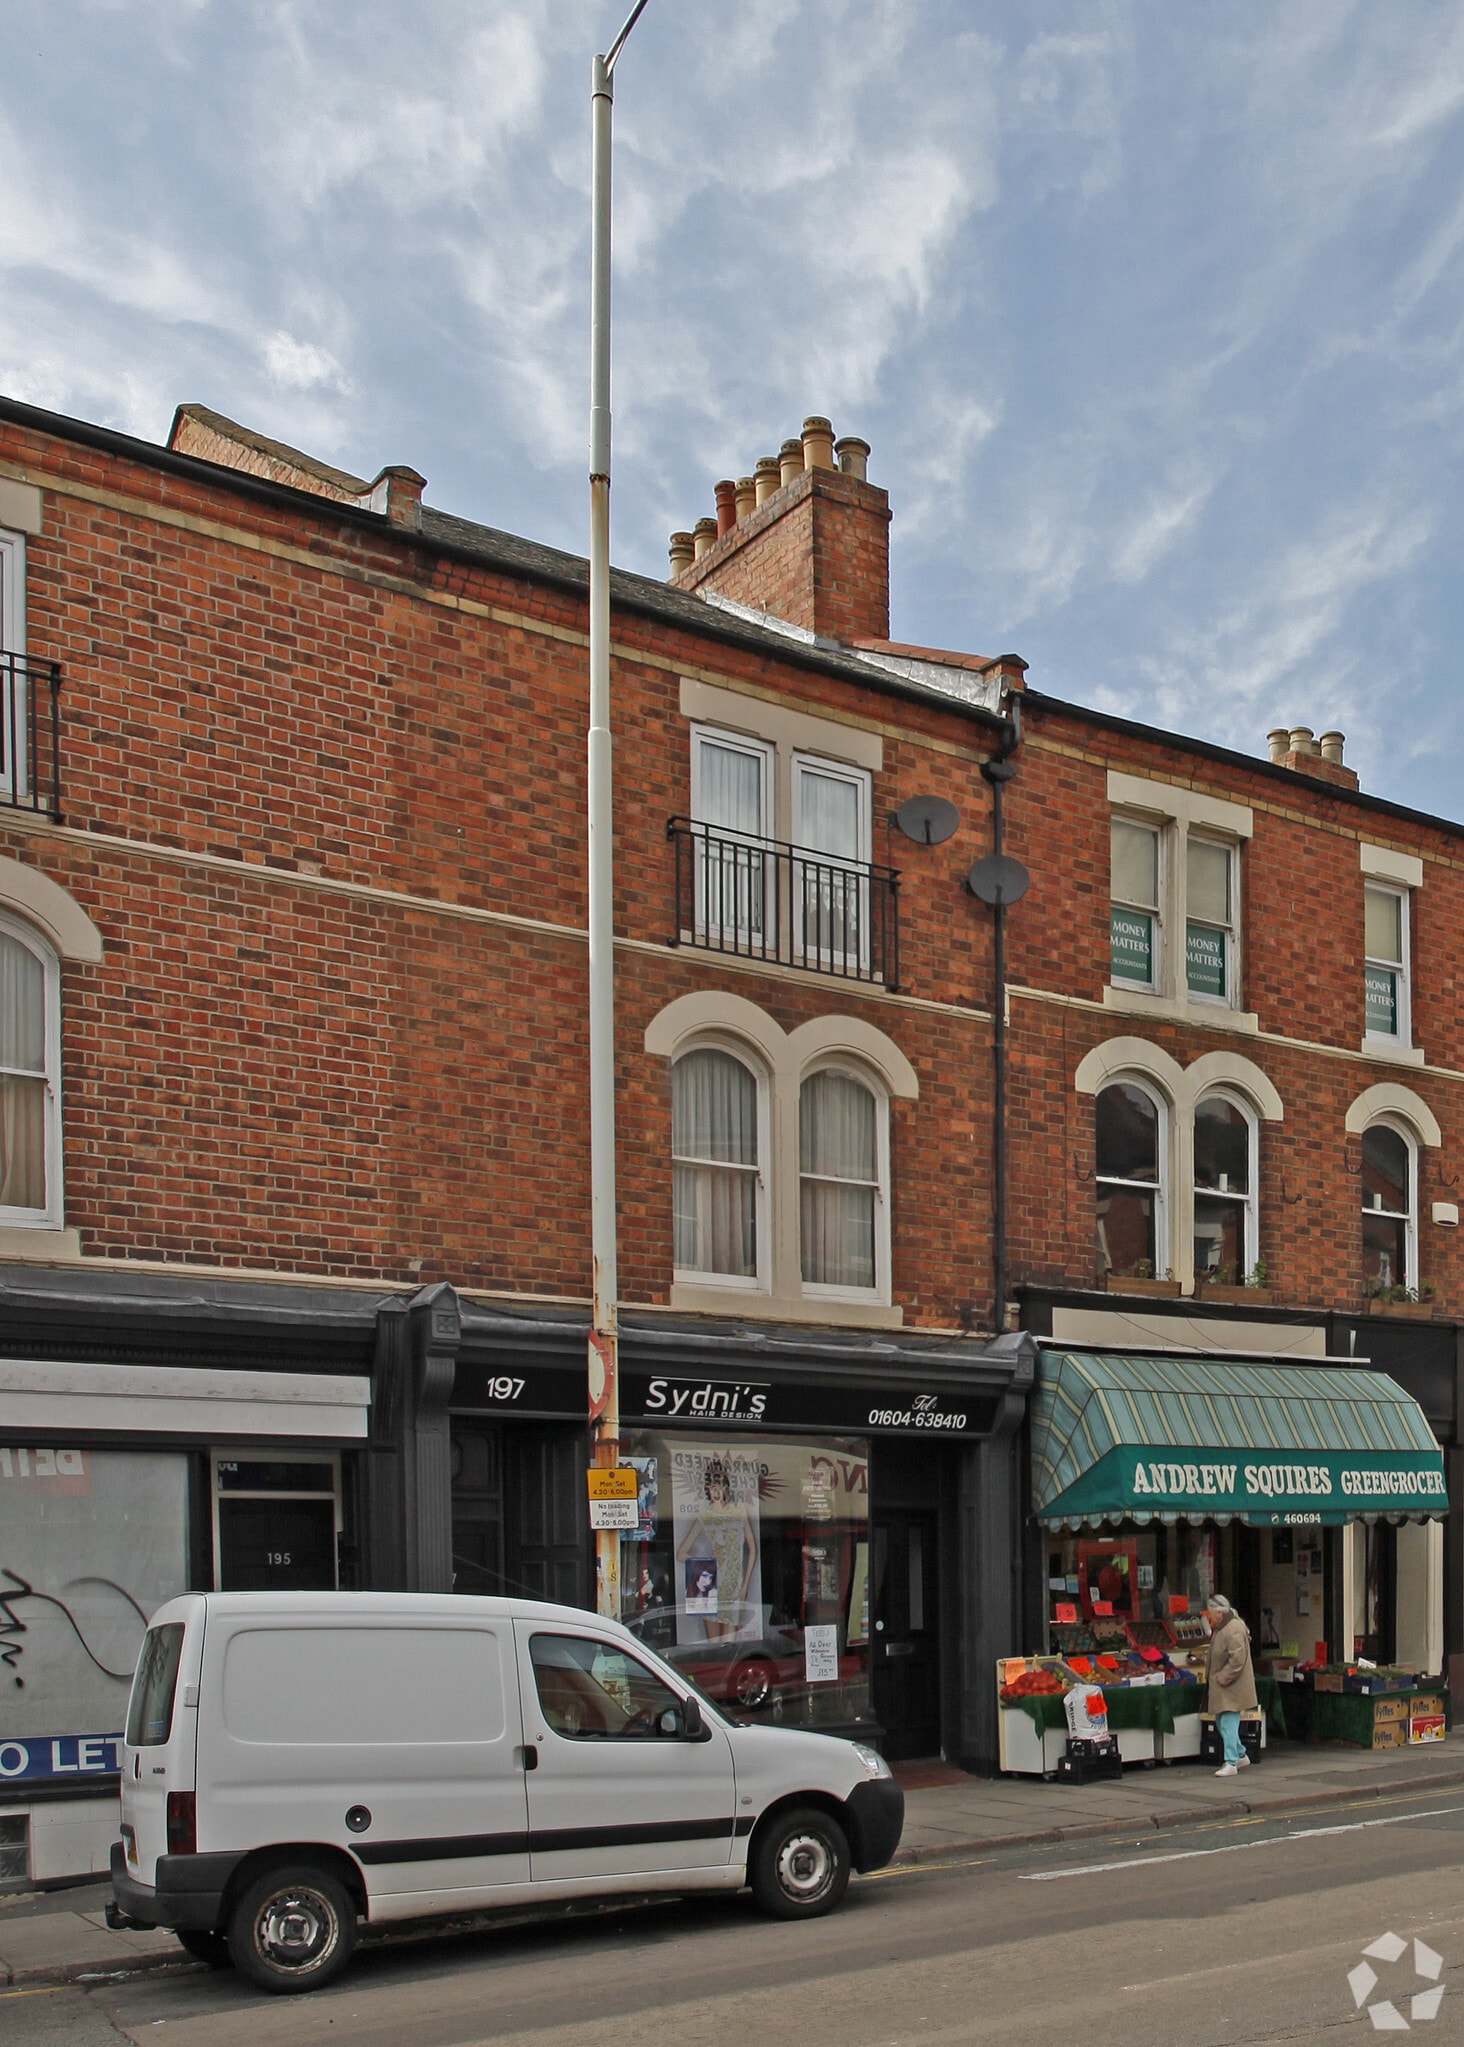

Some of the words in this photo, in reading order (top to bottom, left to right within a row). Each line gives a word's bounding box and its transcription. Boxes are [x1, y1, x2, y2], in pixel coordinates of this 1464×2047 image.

[1112, 921, 1146, 938] MONEY
[1110, 935, 1150, 953] MATTERS
[1187, 937, 1220, 953] MONEY
[1113, 957, 1147, 970] ACCOUNTANTS
[1186, 951, 1223, 968] MATTERS
[1188, 972, 1221, 983] ACCOUNTANTS
[487, 1376, 525, 1400] 197
[645, 1380, 767, 1415] Sydni's
[689, 1410, 717, 1418] HAIR
[720, 1411, 763, 1420] DESIGN
[1133, 1463, 1237, 1494] ANDREW
[1244, 1465, 1333, 1497] SQUIRES
[1341, 1471, 1446, 1495] GREENGROCER
[1283, 1513, 1322, 1524] 460694
[267, 1553, 291, 1565] 195
[51, 1737, 124, 1772] LET
